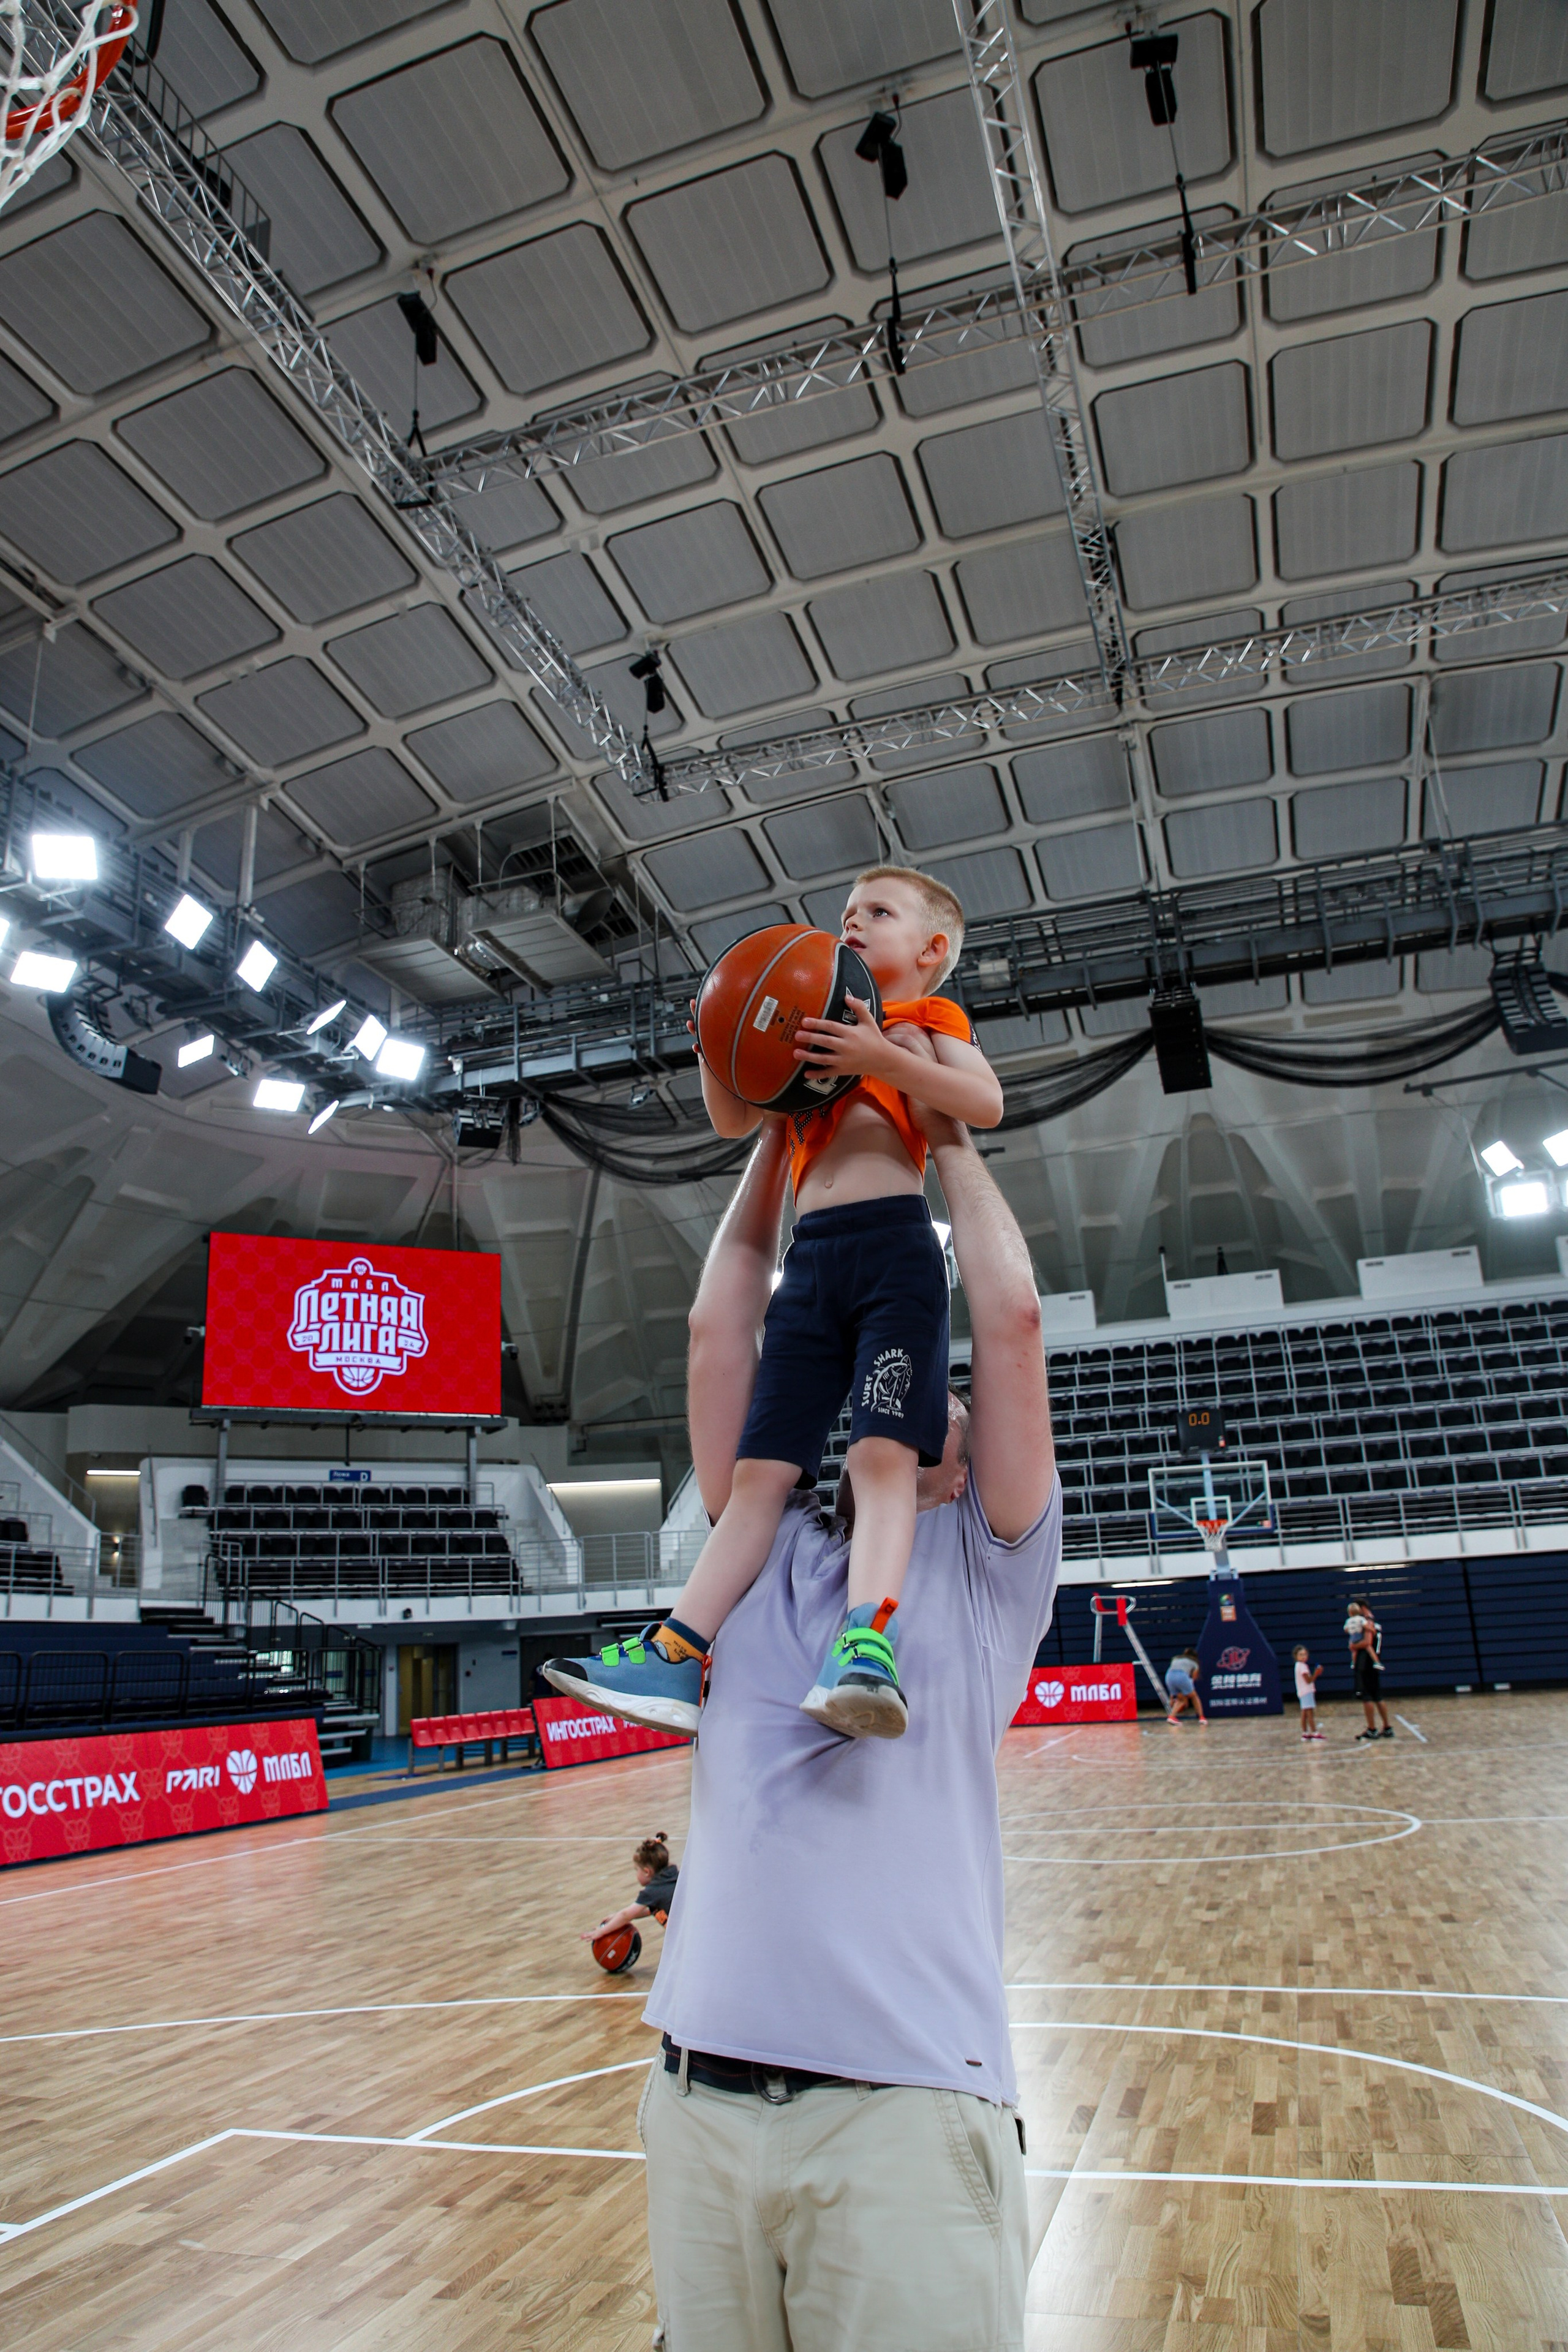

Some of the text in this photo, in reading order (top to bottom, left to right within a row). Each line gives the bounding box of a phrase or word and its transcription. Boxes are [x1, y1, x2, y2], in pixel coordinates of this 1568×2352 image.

[336, 1355, 381, 1364] МОСКВА
[861, 1348, 904, 1407] SURF SHARK
[878, 1407, 891, 1415] SINCE
[1189, 1412, 1210, 1426] 0.0
[1070, 1683, 1121, 1702] МЛБЛ
[545, 1715, 617, 1743] ИНГОССТРАХ
[0, 1771, 140, 1819] ОССТРАХ
[263, 1751, 312, 1783] МЛБЛ
